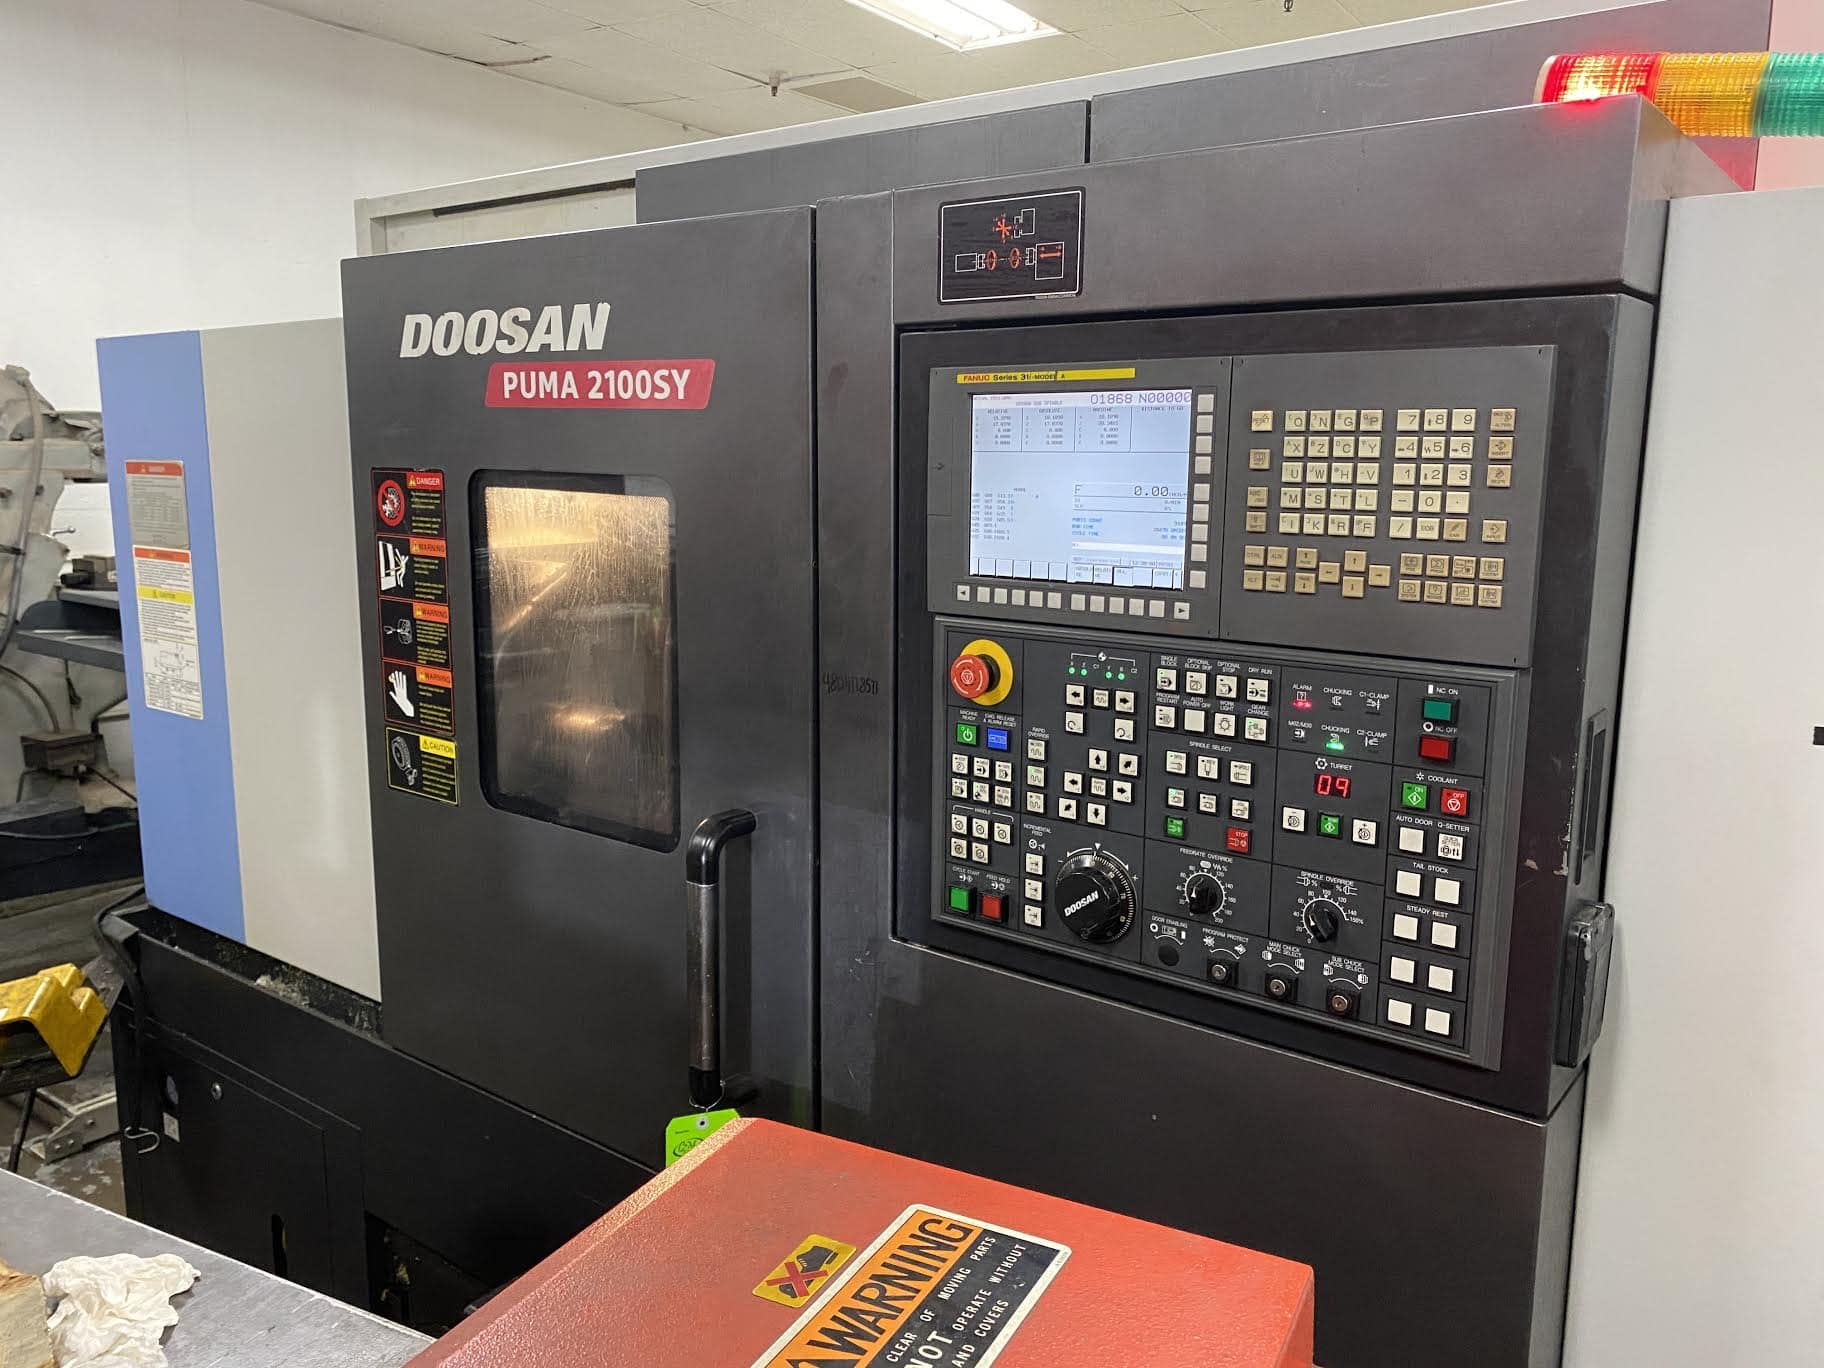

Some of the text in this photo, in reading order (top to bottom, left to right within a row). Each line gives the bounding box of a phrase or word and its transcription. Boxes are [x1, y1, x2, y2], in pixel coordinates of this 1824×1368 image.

[400, 302, 611, 358] DOOSAN
[963, 374, 990, 382] FANUC
[993, 373, 1018, 381] Series
[503, 368, 691, 400] PUMA 2100SY
[1320, 417, 1328, 428] N
[1344, 417, 1354, 428] G
[1370, 417, 1379, 426] P
[1408, 415, 1417, 425] 7
[1435, 414, 1445, 425] 8
[1464, 414, 1473, 425] 9
[1293, 443, 1301, 453] X
[1317, 443, 1326, 454] Z
[1342, 444, 1351, 454] C
[1369, 444, 1377, 454] Y
[1406, 442, 1415, 452] 4
[1433, 442, 1442, 453] 5
[1461, 443, 1471, 453] 6
[1291, 469, 1299, 479] U
[1314, 469, 1325, 480] W
[1341, 470, 1349, 480] H
[1367, 470, 1376, 481] V
[1404, 469, 1410, 479] 1
[1431, 469, 1441, 480] 2
[1459, 470, 1468, 481] 3
[416, 477, 441, 486] DANGER
[1075, 485, 1082, 495] F
[1134, 485, 1169, 497] 0.00
[1289, 495, 1298, 504] M
[1314, 495, 1323, 505] S
[1340, 496, 1348, 505] T
[1365, 496, 1373, 506] L
[1312, 521, 1321, 530] K
[1338, 522, 1346, 531] R
[1363, 522, 1372, 533] F
[418, 543, 445, 553] WARNING
[422, 609, 448, 618] WARNING
[1217, 661, 1241, 669] OPTIONAL
[425, 673, 451, 683] WARNING
[1293, 684, 1313, 692] ALARM
[1323, 688, 1353, 696] CHUCKING
[1359, 691, 1390, 700] C1-CLAMP
[1157, 697, 1178, 705] RESTART
[1248, 709, 1270, 717] CHANGE
[1321, 725, 1350, 734] CHUCKING
[1356, 729, 1388, 739] C2-CLAMP
[430, 743, 454, 753] CAUTION
[1189, 741, 1232, 753] SPINDLE SELECT
[1330, 763, 1353, 771] TURRET
[1428, 775, 1458, 785] COOLANT
[1317, 774, 1350, 798] 09
[1396, 815, 1433, 827] AUTO DOOR
[1438, 822, 1470, 833] Q-SETTER
[1180, 848, 1233, 864] FEEDRATE OVERRIDE
[1413, 862, 1450, 874] TAIL STOCK
[1301, 871, 1355, 887] SPINDLE OVERRIDE
[1064, 890, 1100, 917] DOOSAN
[1407, 905, 1449, 919] STEADY REST
[1267, 946, 1302, 958] MODE SELECT
[1282, 944, 1301, 953] CHUCK
[1328, 960, 1365, 974] MODE SELECT
[1344, 959, 1362, 968] CHUCK
[806, 1217, 983, 1359] WARNING
[886, 1236, 997, 1363] CLEAR OF MOVING PARTS
[904, 1244, 1027, 1368] NOT OPERATE WITHOUT
[951, 1300, 1010, 1368] AND COVERS
